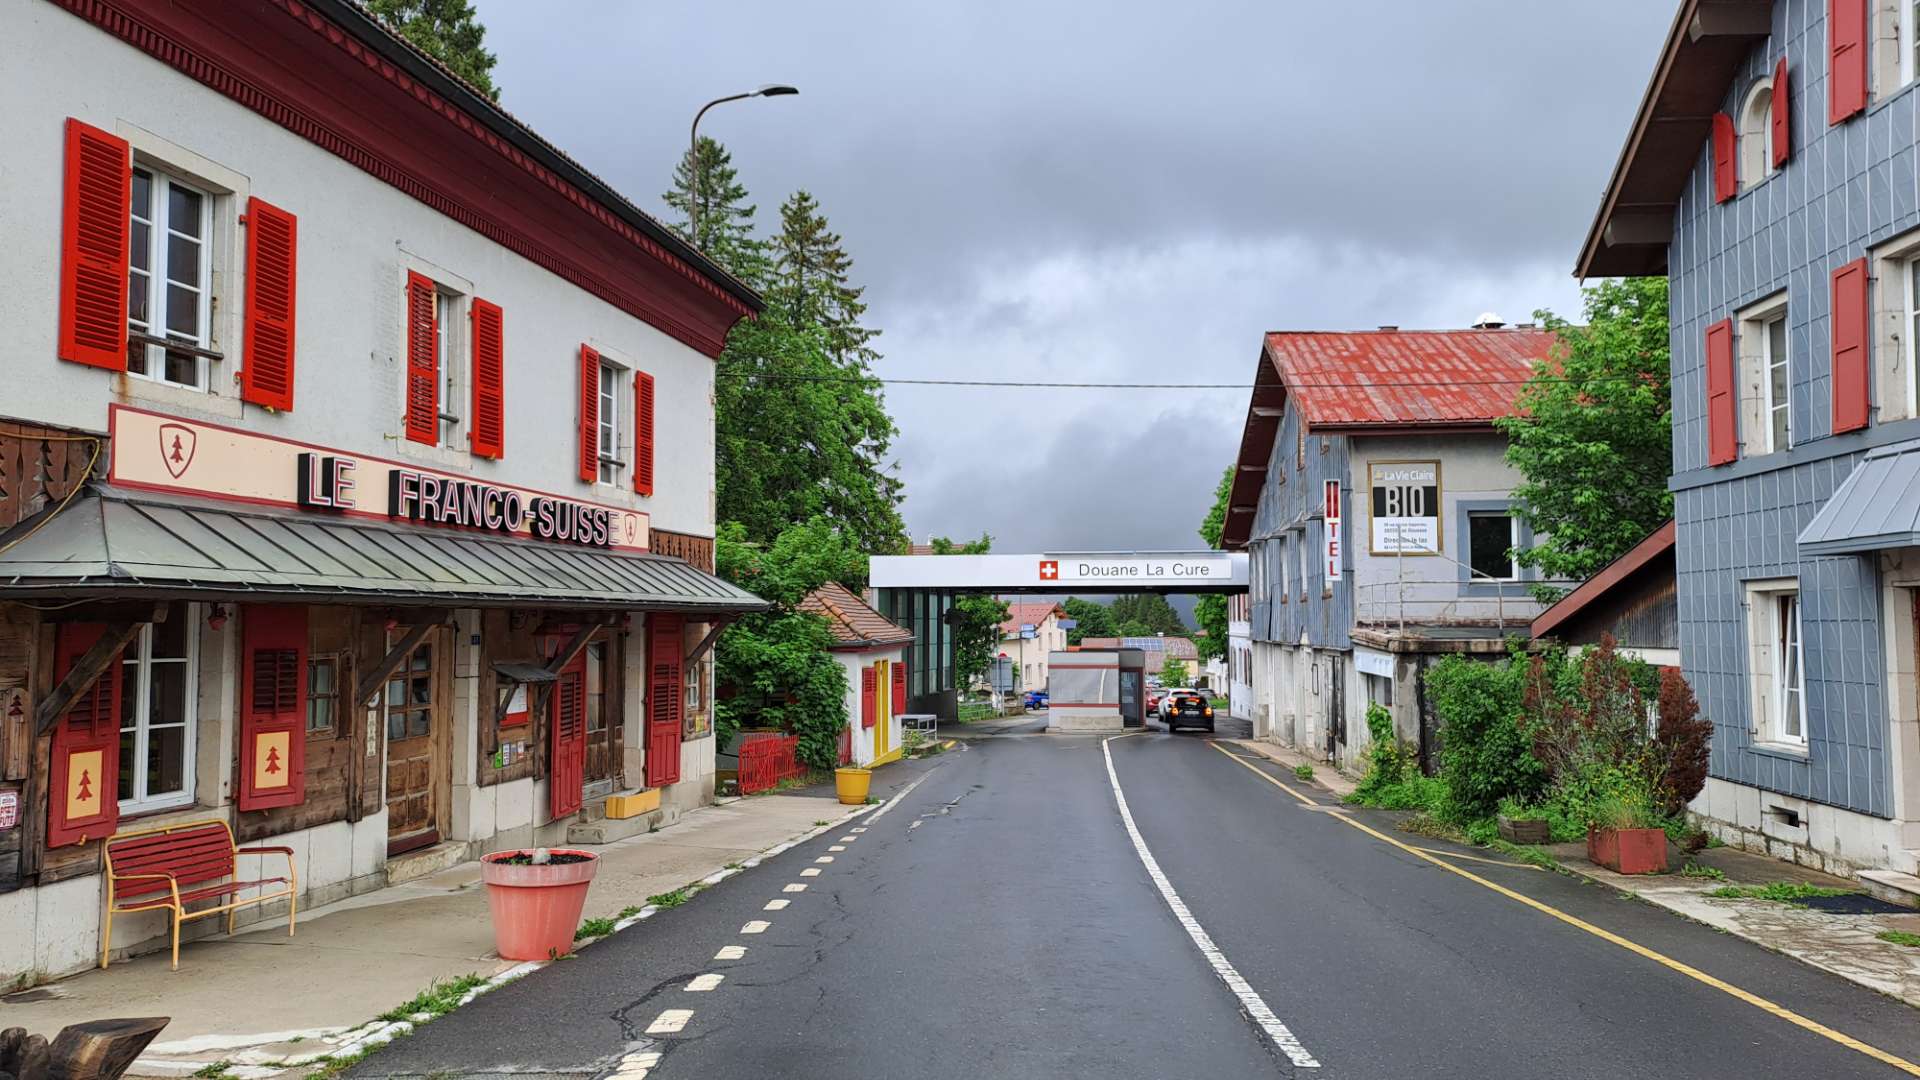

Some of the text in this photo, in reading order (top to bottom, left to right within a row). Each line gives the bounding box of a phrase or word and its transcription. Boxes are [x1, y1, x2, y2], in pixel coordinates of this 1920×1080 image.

[1384, 470, 1434, 480] La Vie Claire
[306, 453, 620, 546] LE FRANCO-SUISSE
[1385, 486, 1424, 517] BIO
[1079, 563, 1210, 576] Douane La Cure
